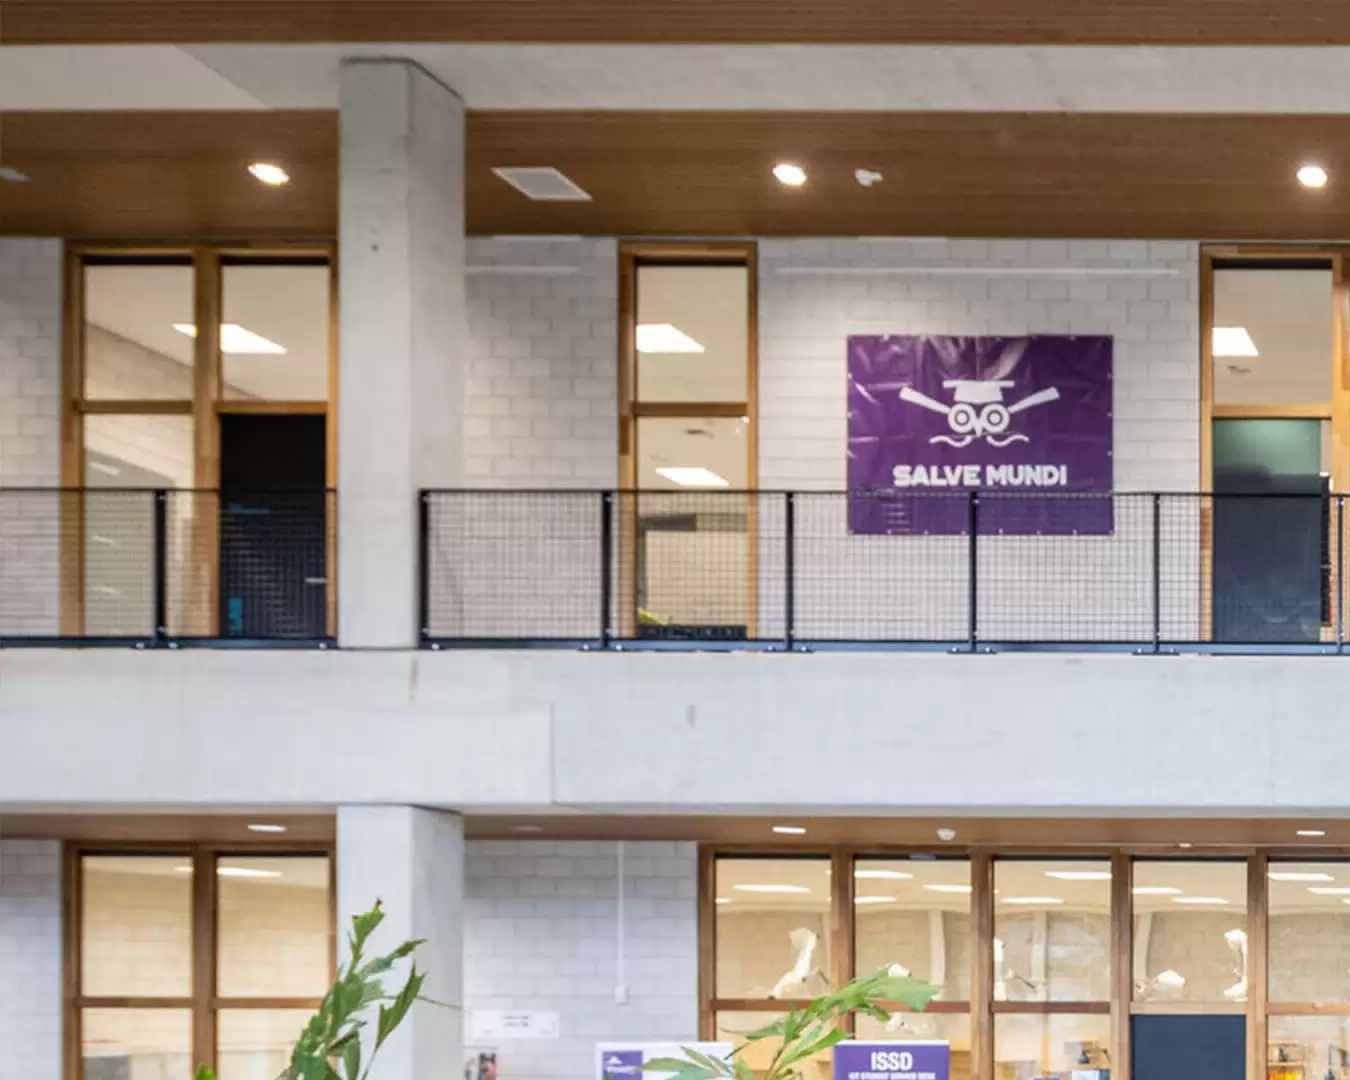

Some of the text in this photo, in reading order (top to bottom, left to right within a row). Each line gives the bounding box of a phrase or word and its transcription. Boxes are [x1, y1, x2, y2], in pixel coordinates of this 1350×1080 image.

[893, 464, 1067, 487] SALVE MUNDI
[871, 1051, 913, 1071] ISSD
